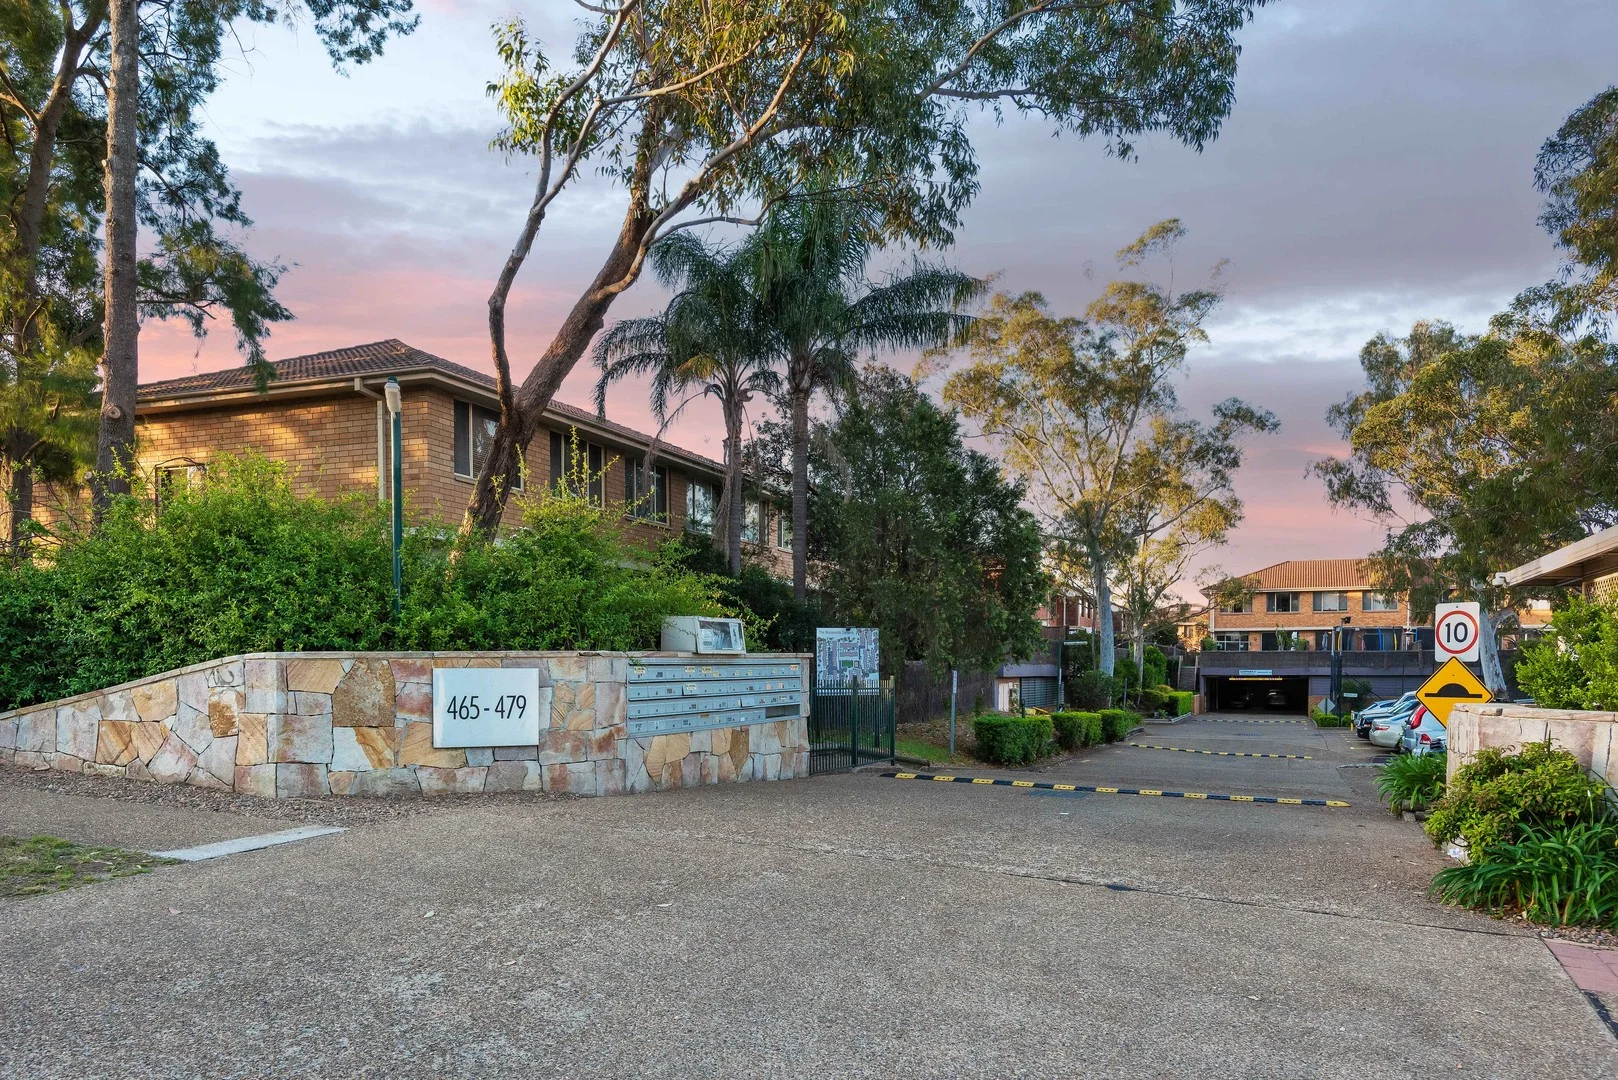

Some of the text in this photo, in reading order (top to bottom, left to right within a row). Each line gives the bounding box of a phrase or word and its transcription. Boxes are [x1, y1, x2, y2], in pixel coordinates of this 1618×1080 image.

[1445, 621, 1468, 643] 10
[446, 695, 480, 720] 465
[494, 694, 527, 719] 479
